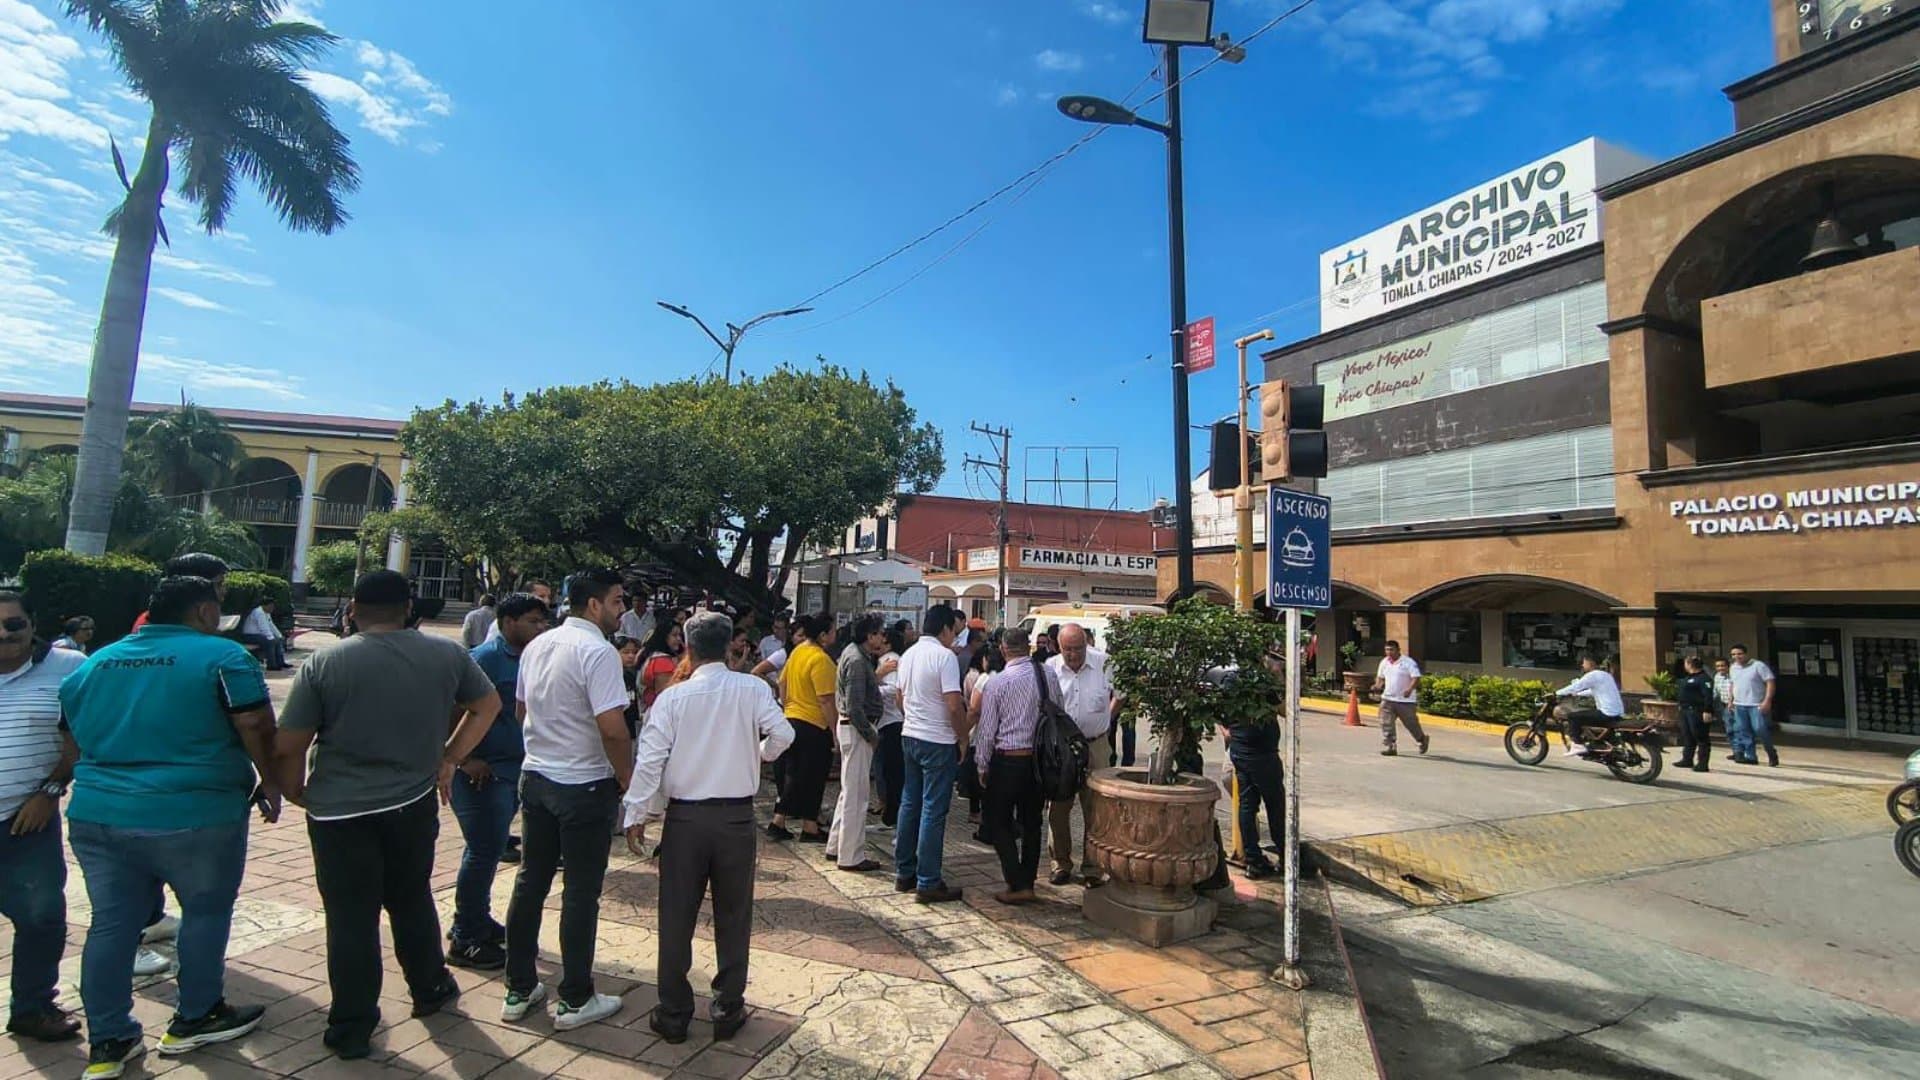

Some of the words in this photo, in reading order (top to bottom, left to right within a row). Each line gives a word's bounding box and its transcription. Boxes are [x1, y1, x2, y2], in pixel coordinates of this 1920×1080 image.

[1849, 15, 1863, 30] 6
[1396, 161, 1565, 253] ARCHIVO
[1380, 192, 1588, 289] MUNICIPAL
[1428, 260, 1482, 289] CHIAPAS
[1498, 241, 1532, 266] 2024
[1546, 223, 1586, 248] 2027
[1276, 497, 1327, 519] ASCENSO
[1670, 494, 1777, 516] PALACIO
[1786, 481, 1920, 507] MUNICIP
[1686, 511, 1799, 535] TONALÁ,
[1801, 505, 1920, 528] CHIAPA
[1022, 549, 1099, 566] FARMACIA
[1104, 555, 1122, 567] LA
[1274, 581, 1327, 601] DESCENSO
